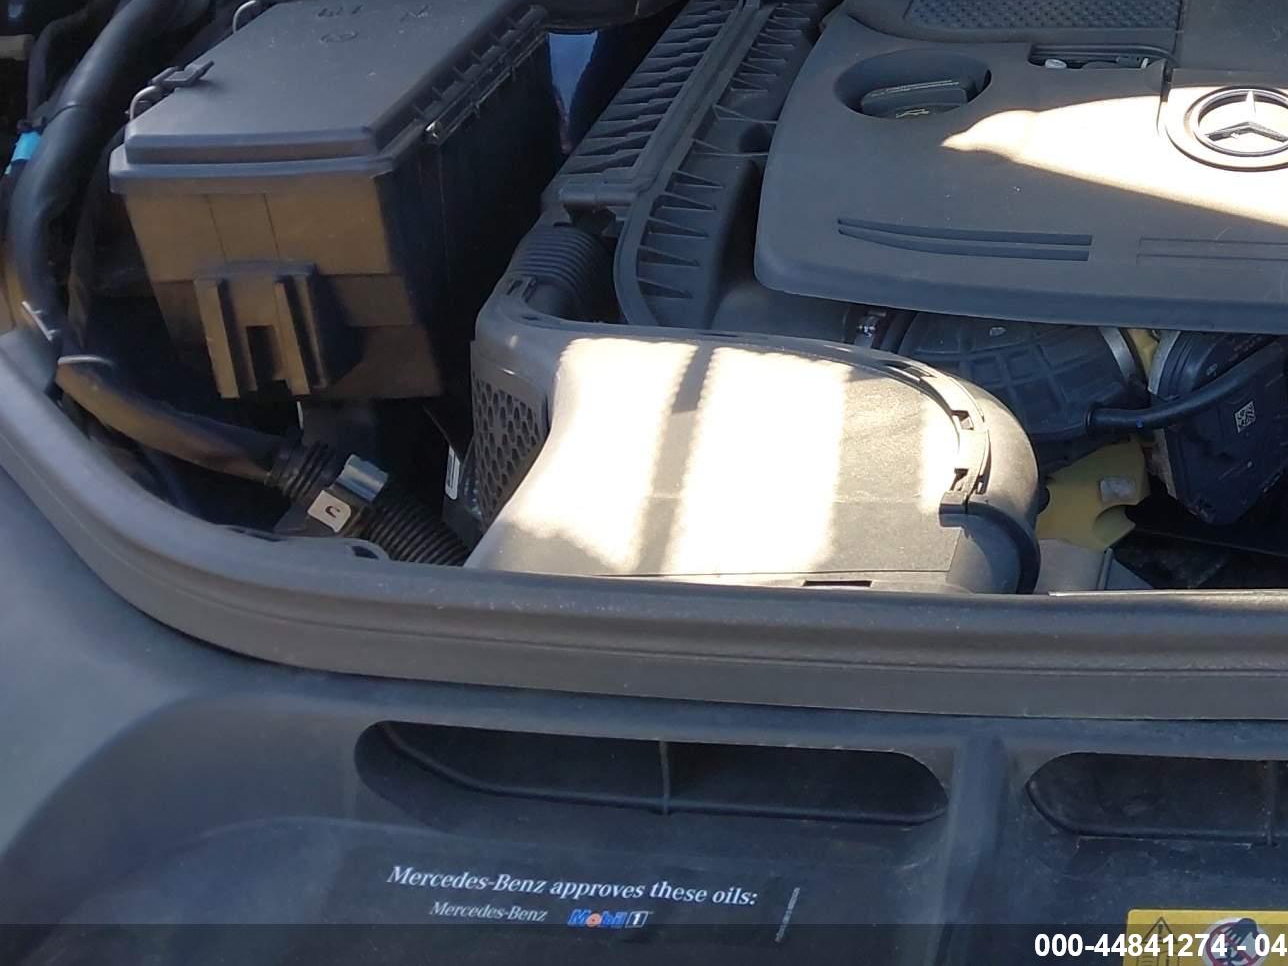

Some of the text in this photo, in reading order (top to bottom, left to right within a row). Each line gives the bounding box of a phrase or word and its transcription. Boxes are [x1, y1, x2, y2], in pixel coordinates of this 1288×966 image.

[387, 865, 759, 906] Mercedes-Benz approves these oils:
[428, 901, 548, 923] Mercedes-Benz
